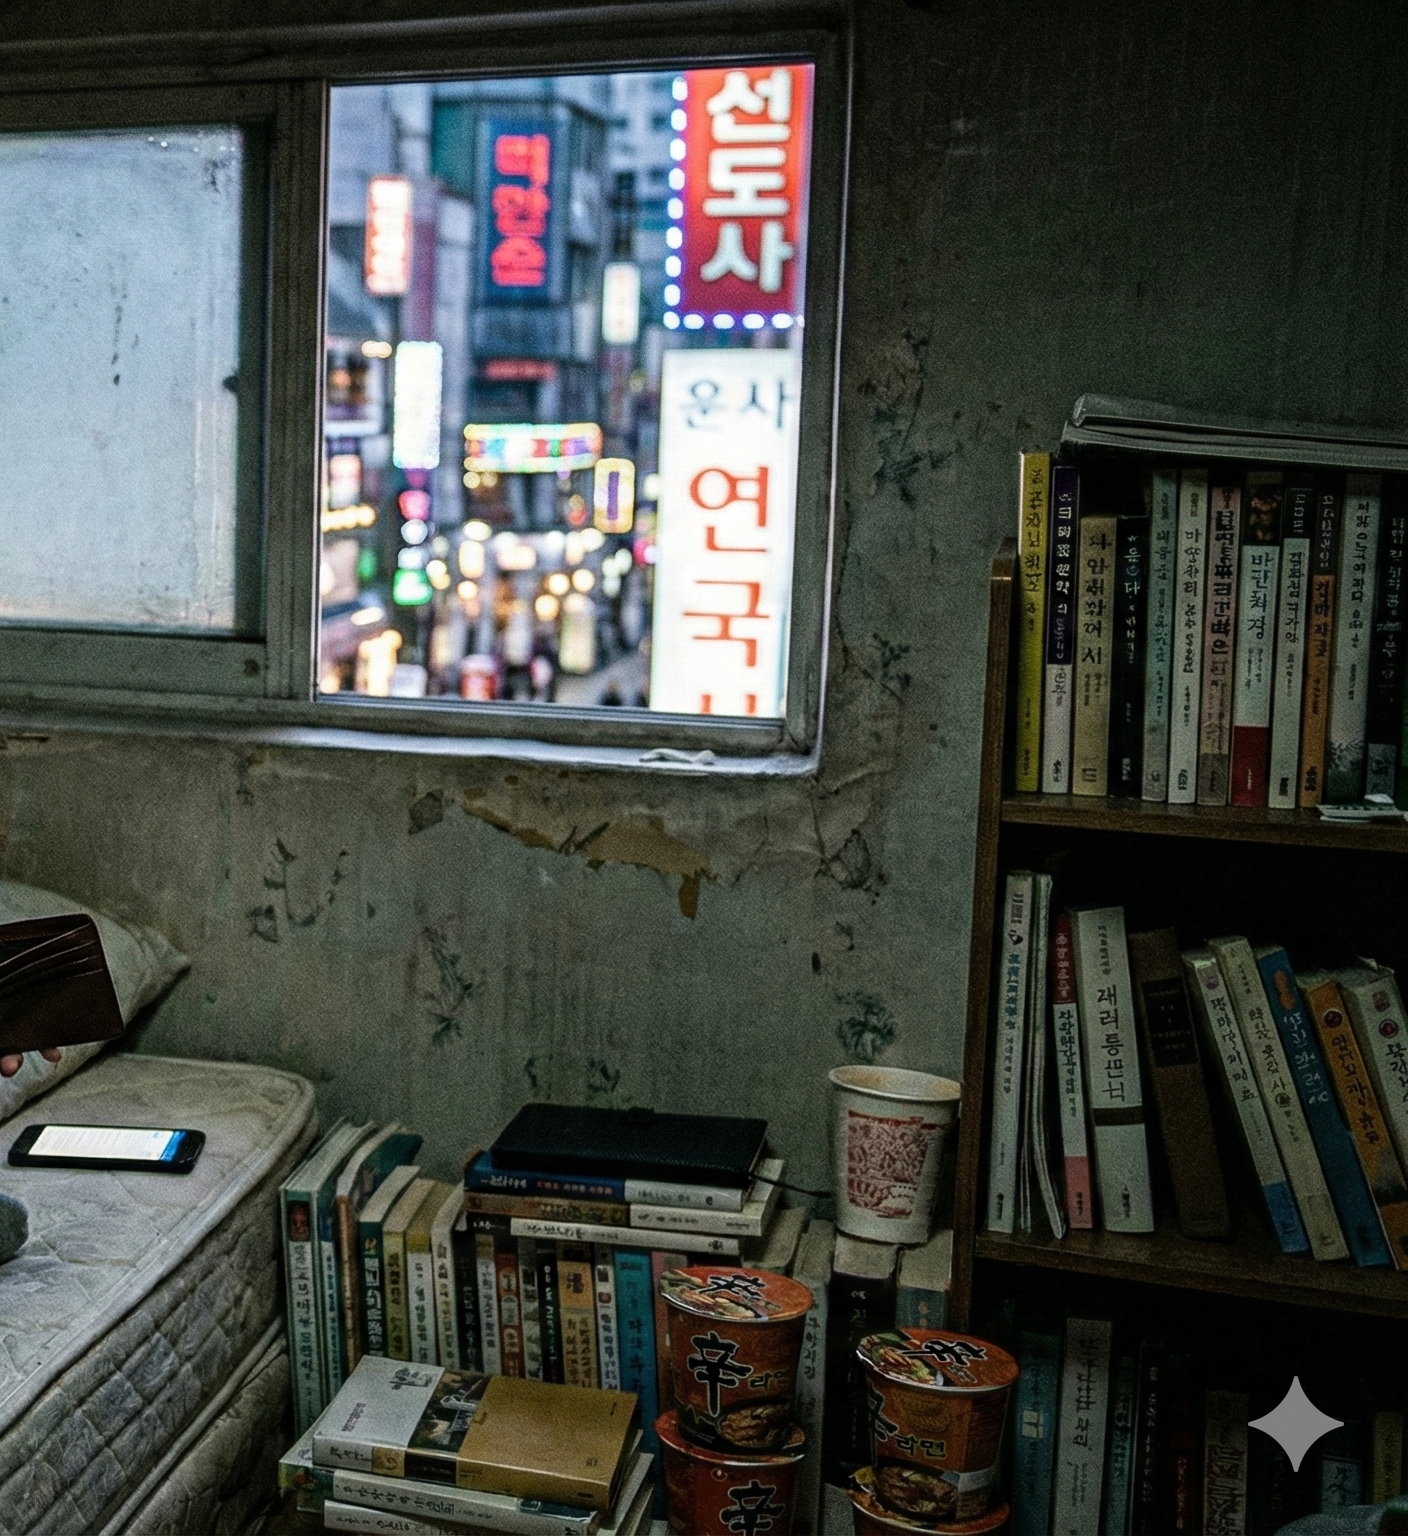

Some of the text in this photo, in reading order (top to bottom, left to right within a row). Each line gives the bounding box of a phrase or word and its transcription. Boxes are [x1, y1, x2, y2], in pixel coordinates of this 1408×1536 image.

[700, 68, 795, 294] 선도사
[682, 465, 770, 716] 연국
[687, 1331, 754, 1417] 辛
[895, 1434, 947, 1459] 라면
